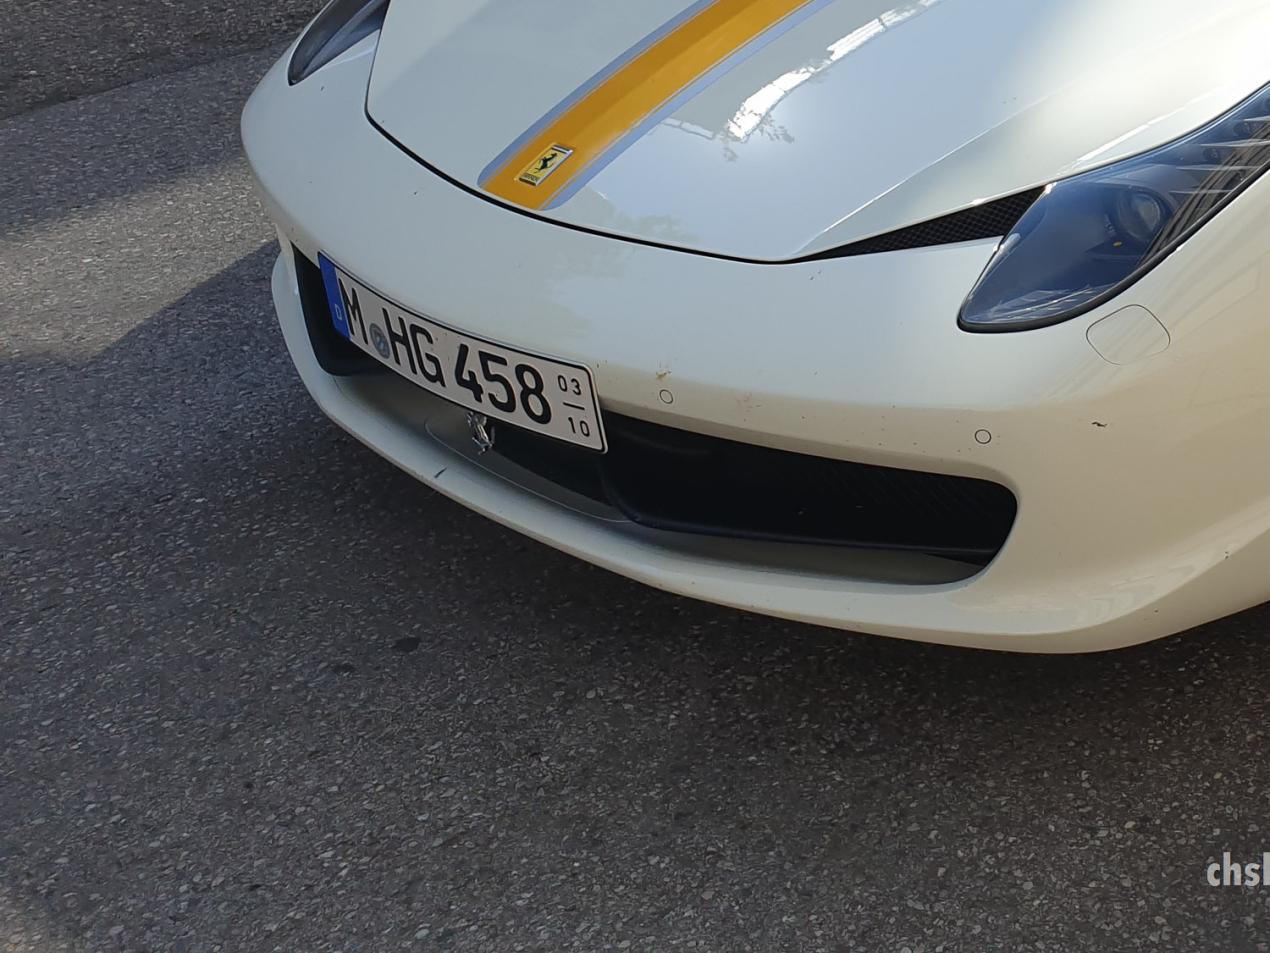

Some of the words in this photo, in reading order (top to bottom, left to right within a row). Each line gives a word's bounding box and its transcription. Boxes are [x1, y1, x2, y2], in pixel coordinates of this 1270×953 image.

[338, 278, 369, 345] M
[382, 307, 446, 388] HG
[455, 343, 552, 424] 458
[557, 375, 582, 396] 03
[567, 416, 590, 437] 10
